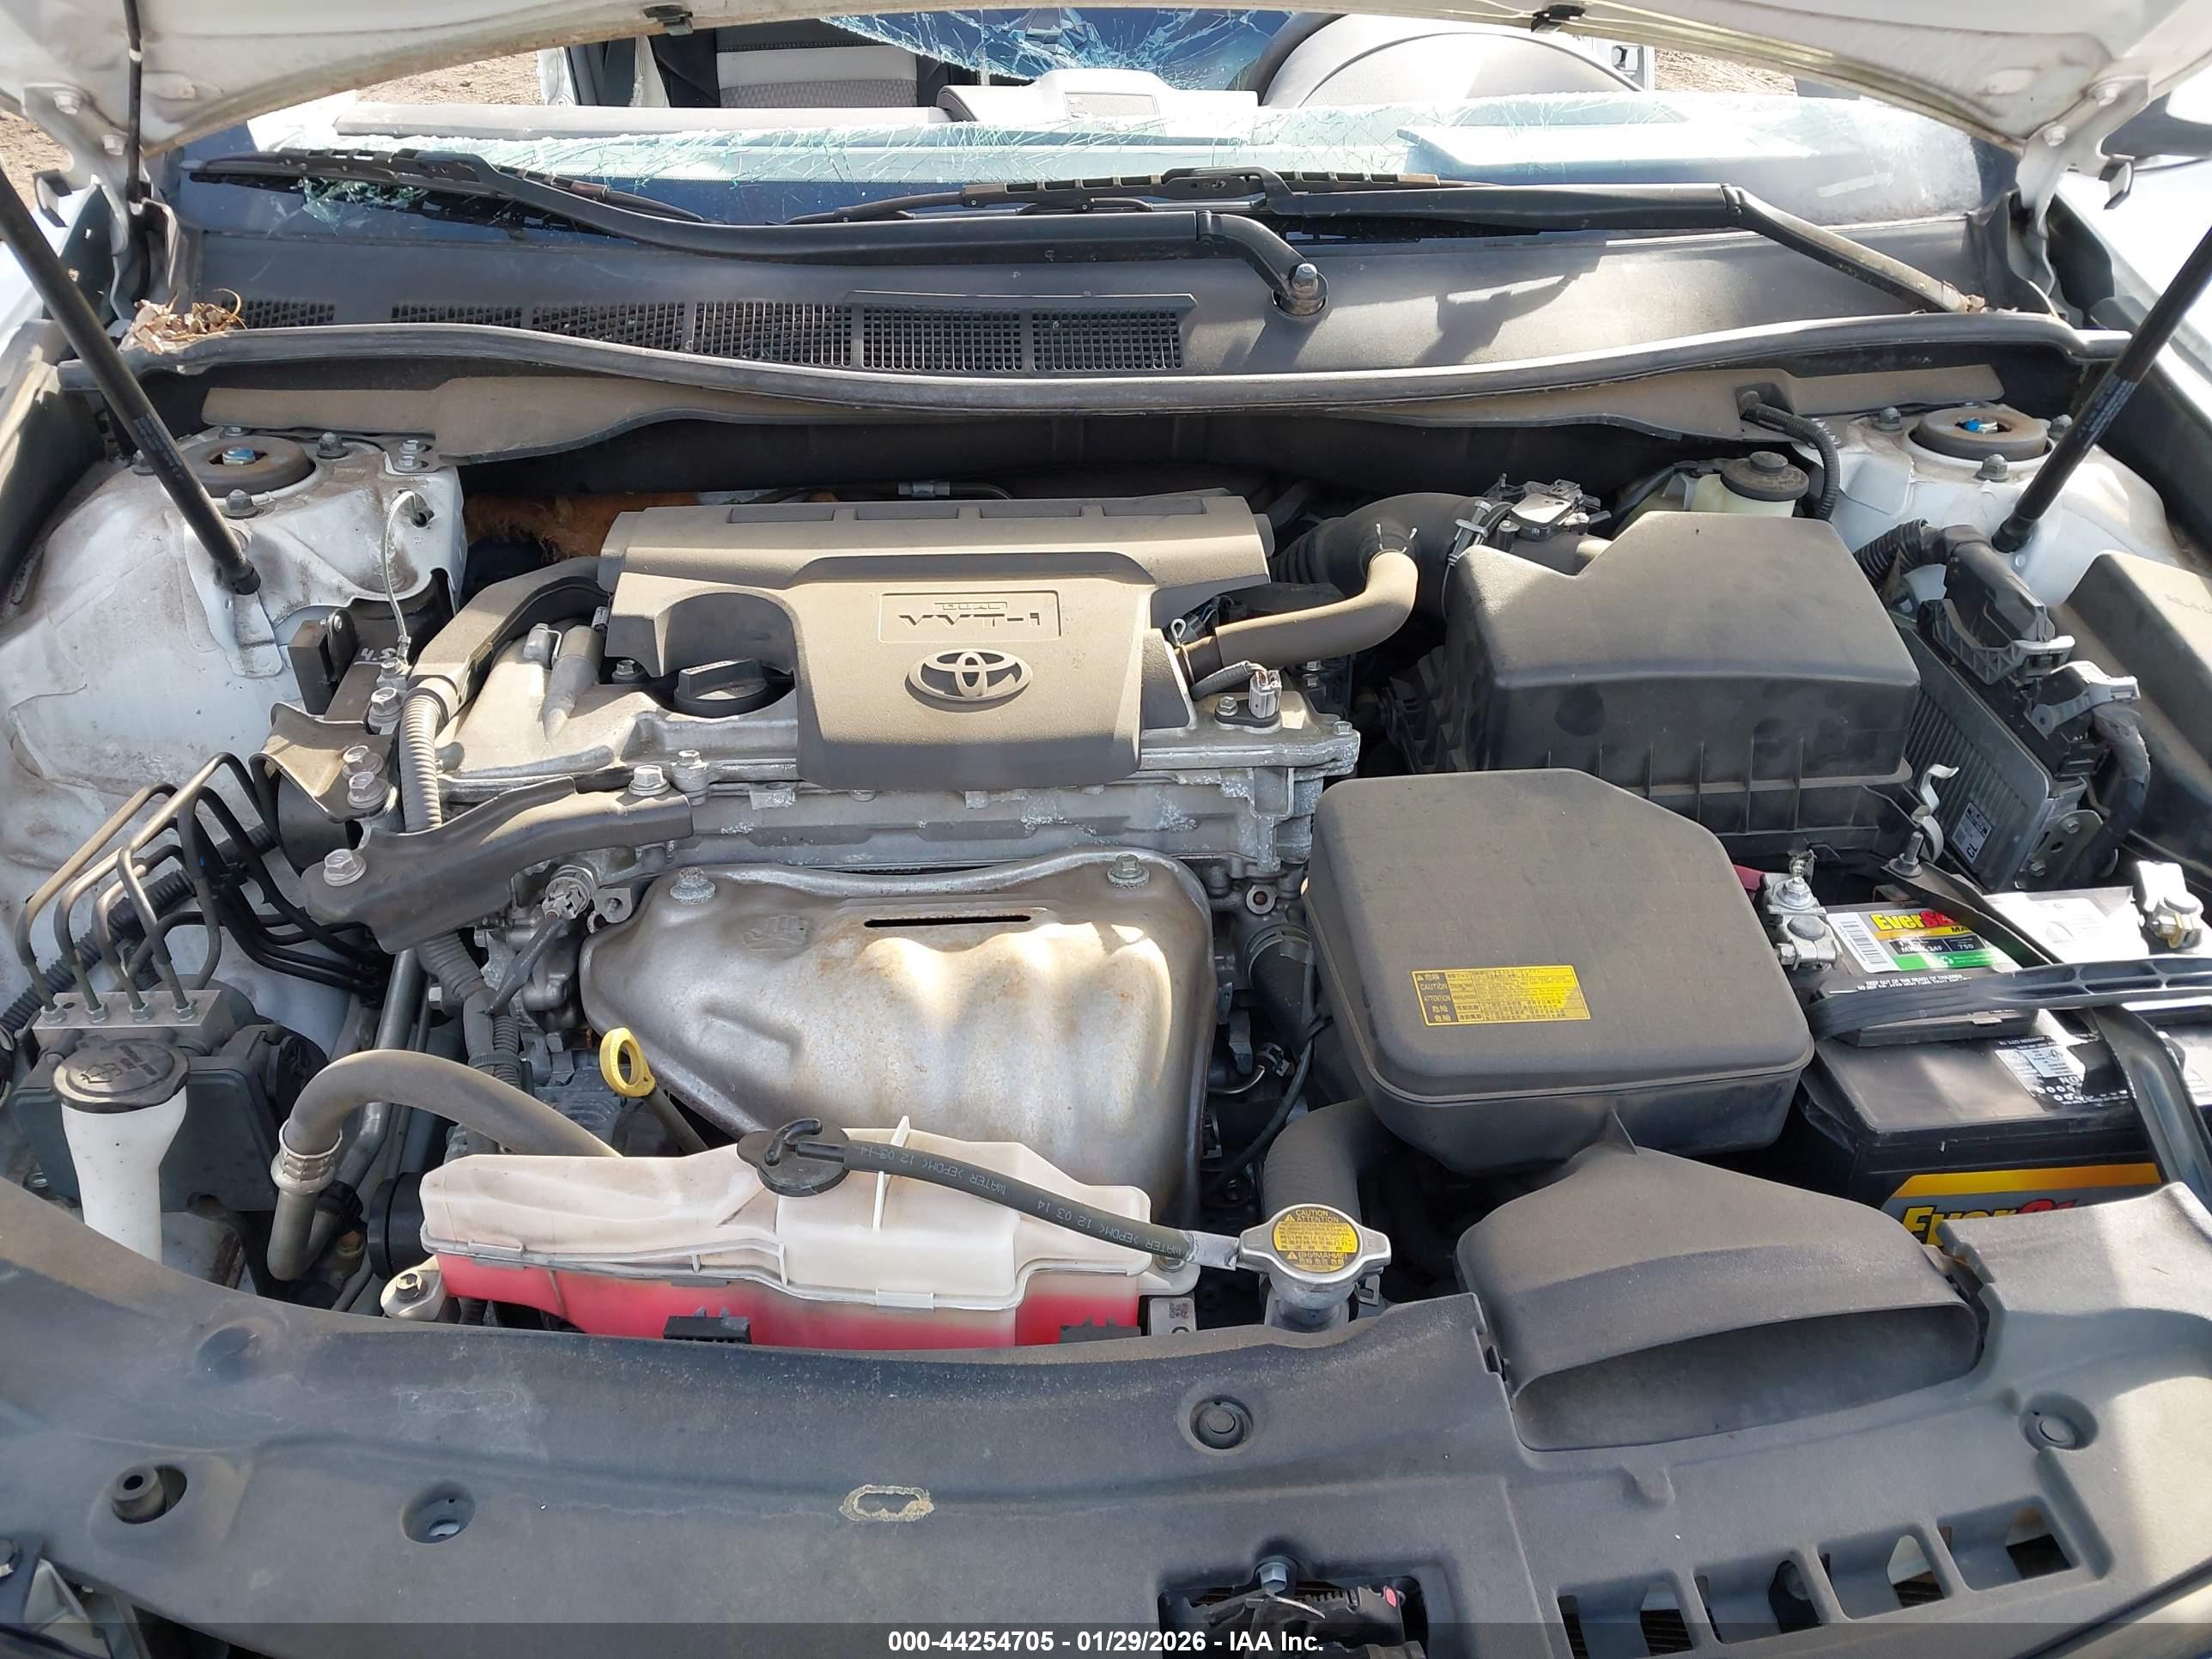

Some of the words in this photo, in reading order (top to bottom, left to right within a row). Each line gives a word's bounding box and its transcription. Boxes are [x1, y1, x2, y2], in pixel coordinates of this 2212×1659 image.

[1419, 982, 1448, 991] CAUTION
[1424, 994, 1451, 1003] ATTENTION
[878, 1148, 895, 1160] 03
[900, 1154, 915, 1166] 12
[969, 1174, 1006, 1195] WATER
[1036, 1199, 1050, 1213] 14
[1055, 1207, 1073, 1222] 03
[1077, 1215, 1092, 1230] 12
[1146, 1237, 1182, 1257] WATER
